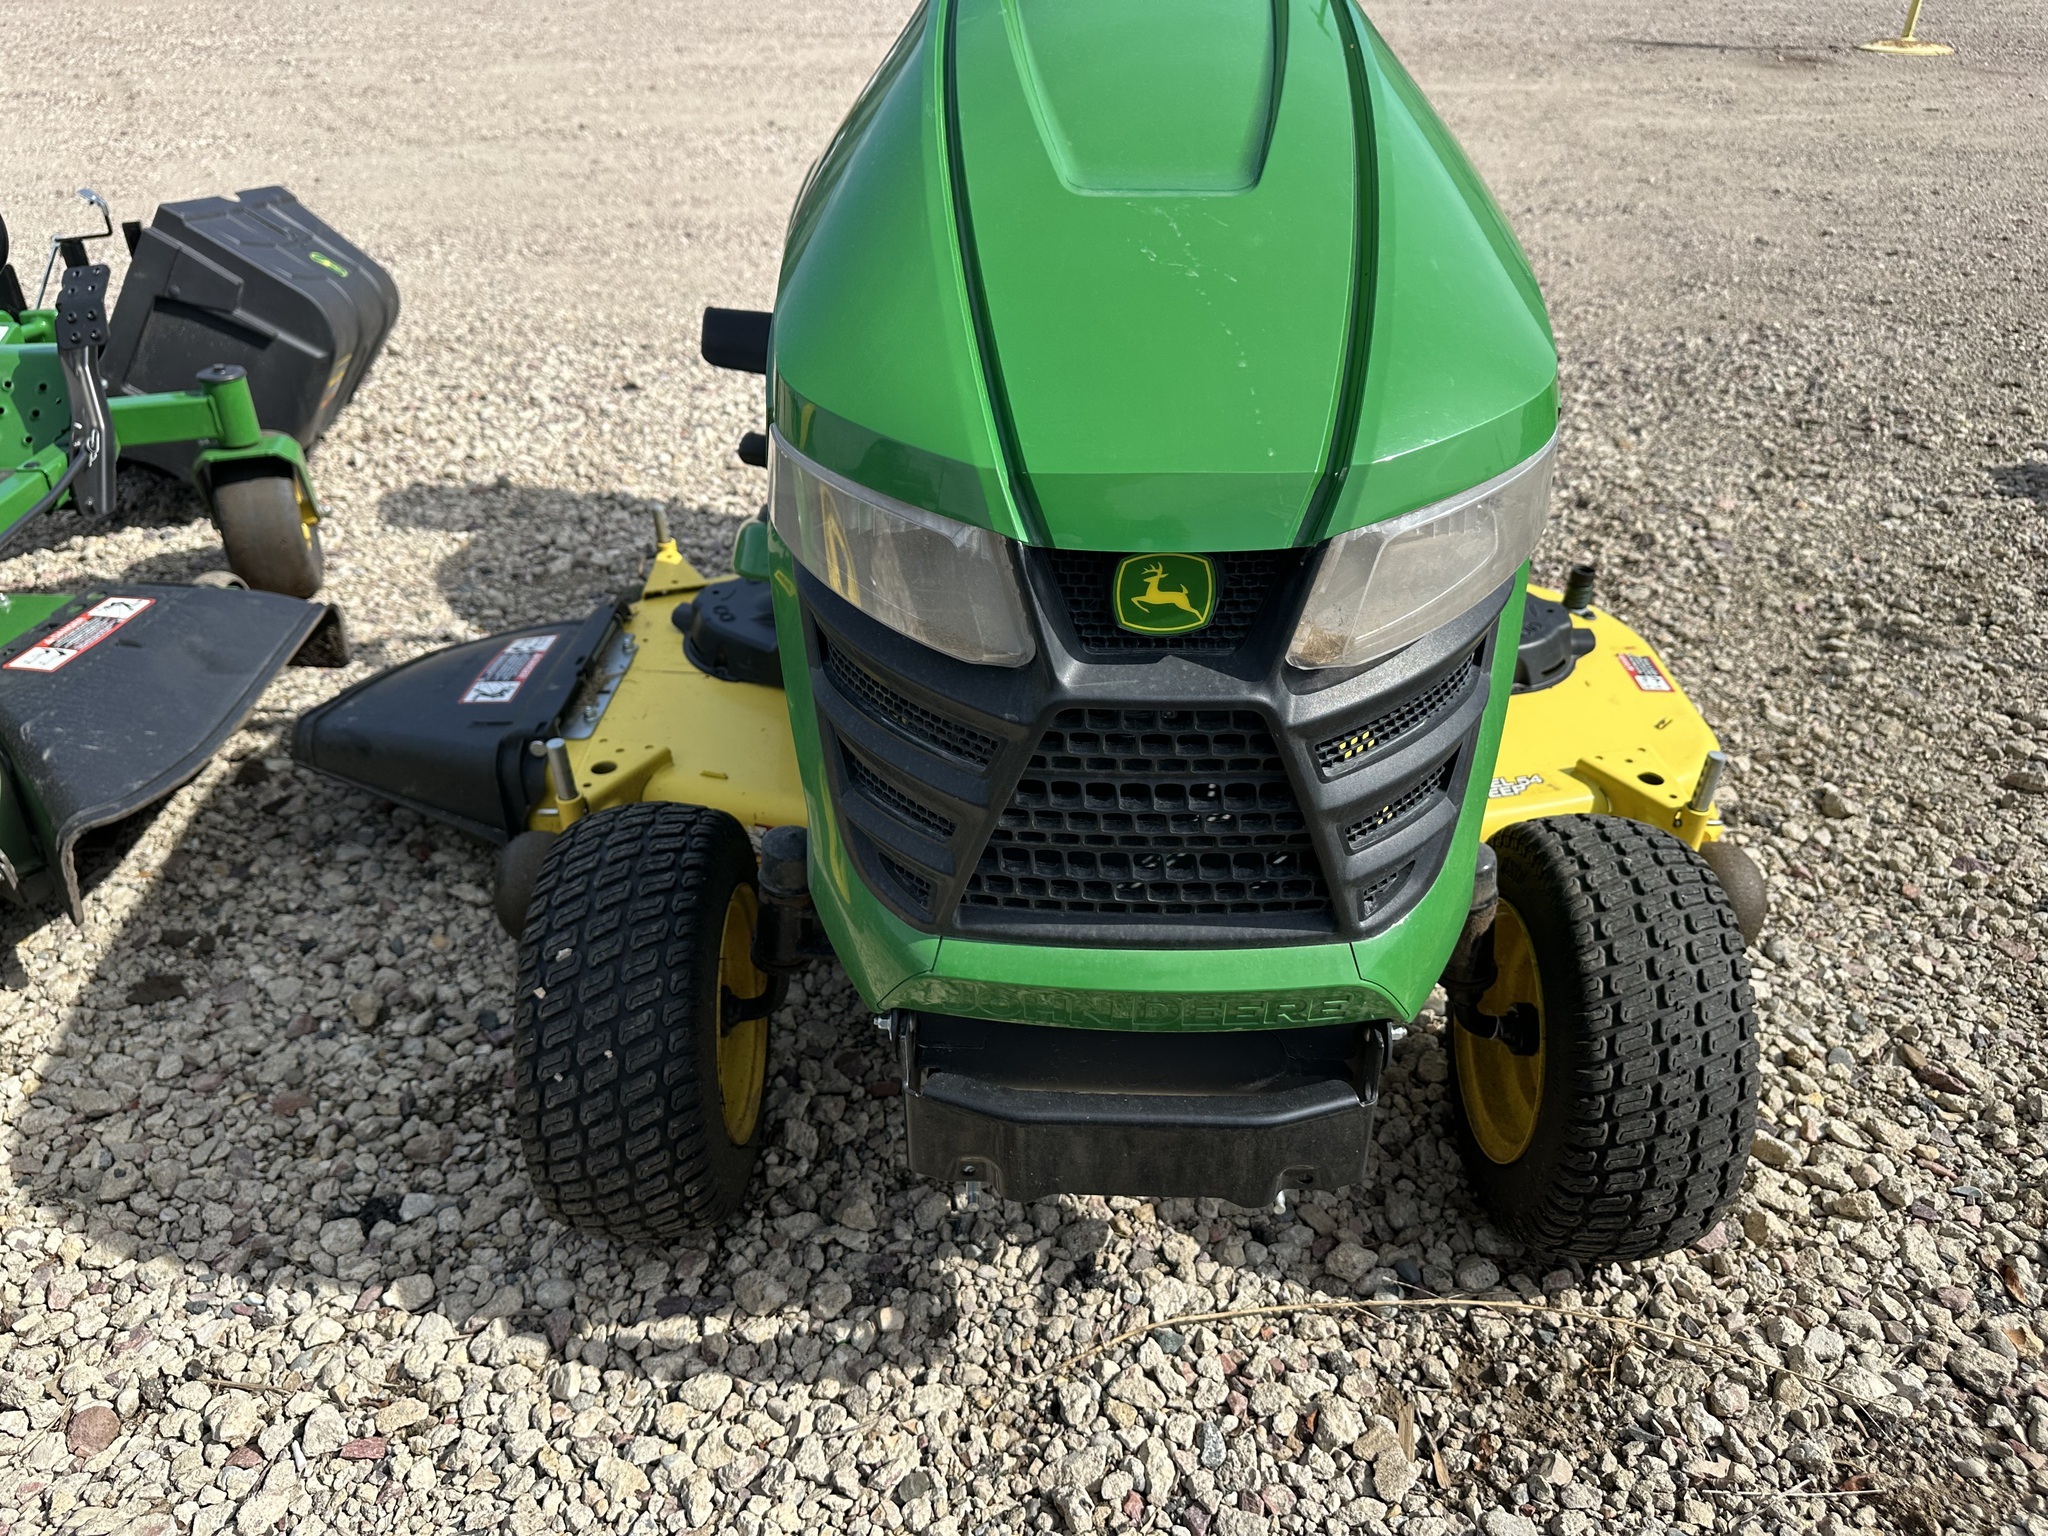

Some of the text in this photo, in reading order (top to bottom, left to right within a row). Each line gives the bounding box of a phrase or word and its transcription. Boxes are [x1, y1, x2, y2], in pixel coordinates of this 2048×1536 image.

[1490, 777, 1516, 788] EL
[1488, 784, 1528, 799] EEP
[943, 985, 1353, 1026] JOHN DEERE
